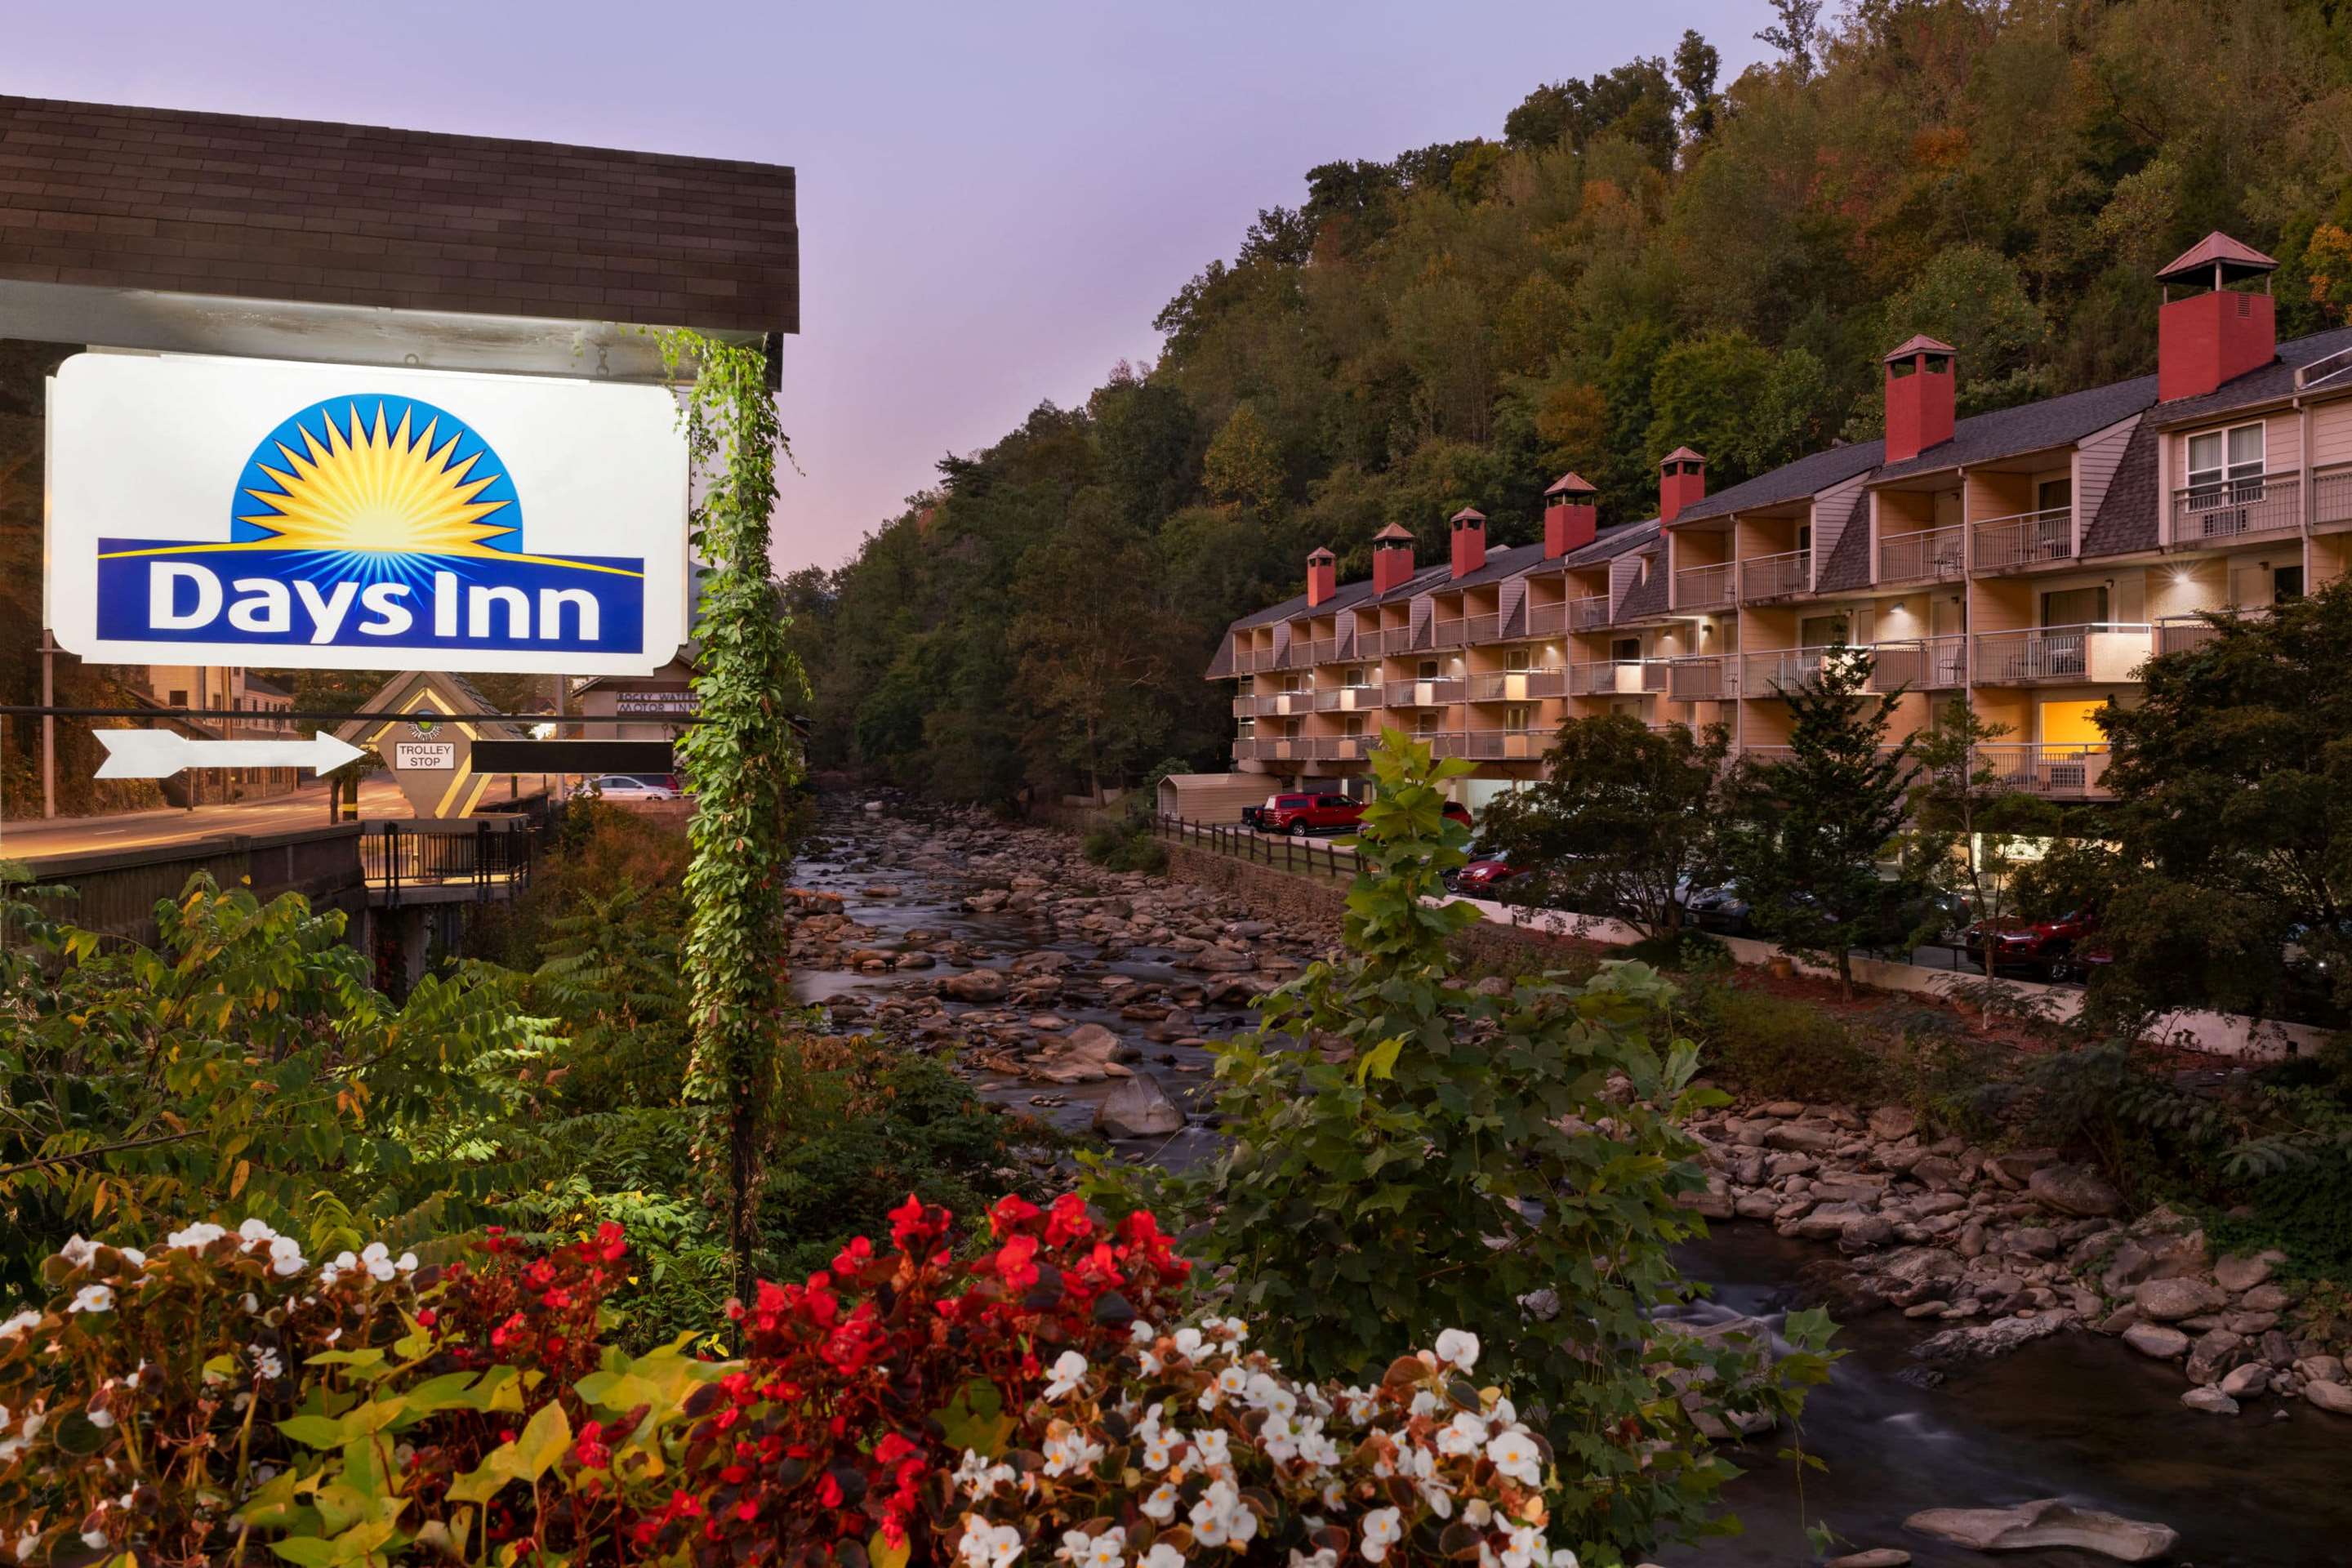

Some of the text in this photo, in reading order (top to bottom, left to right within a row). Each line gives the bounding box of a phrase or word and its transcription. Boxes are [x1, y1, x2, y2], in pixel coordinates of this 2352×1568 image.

[149, 561, 599, 644] Days Inn
[618, 693, 653, 701] ROCKY
[620, 703, 697, 712] MOTOR INN
[399, 746, 451, 755] TROLLEY
[410, 757, 441, 766] STOP
